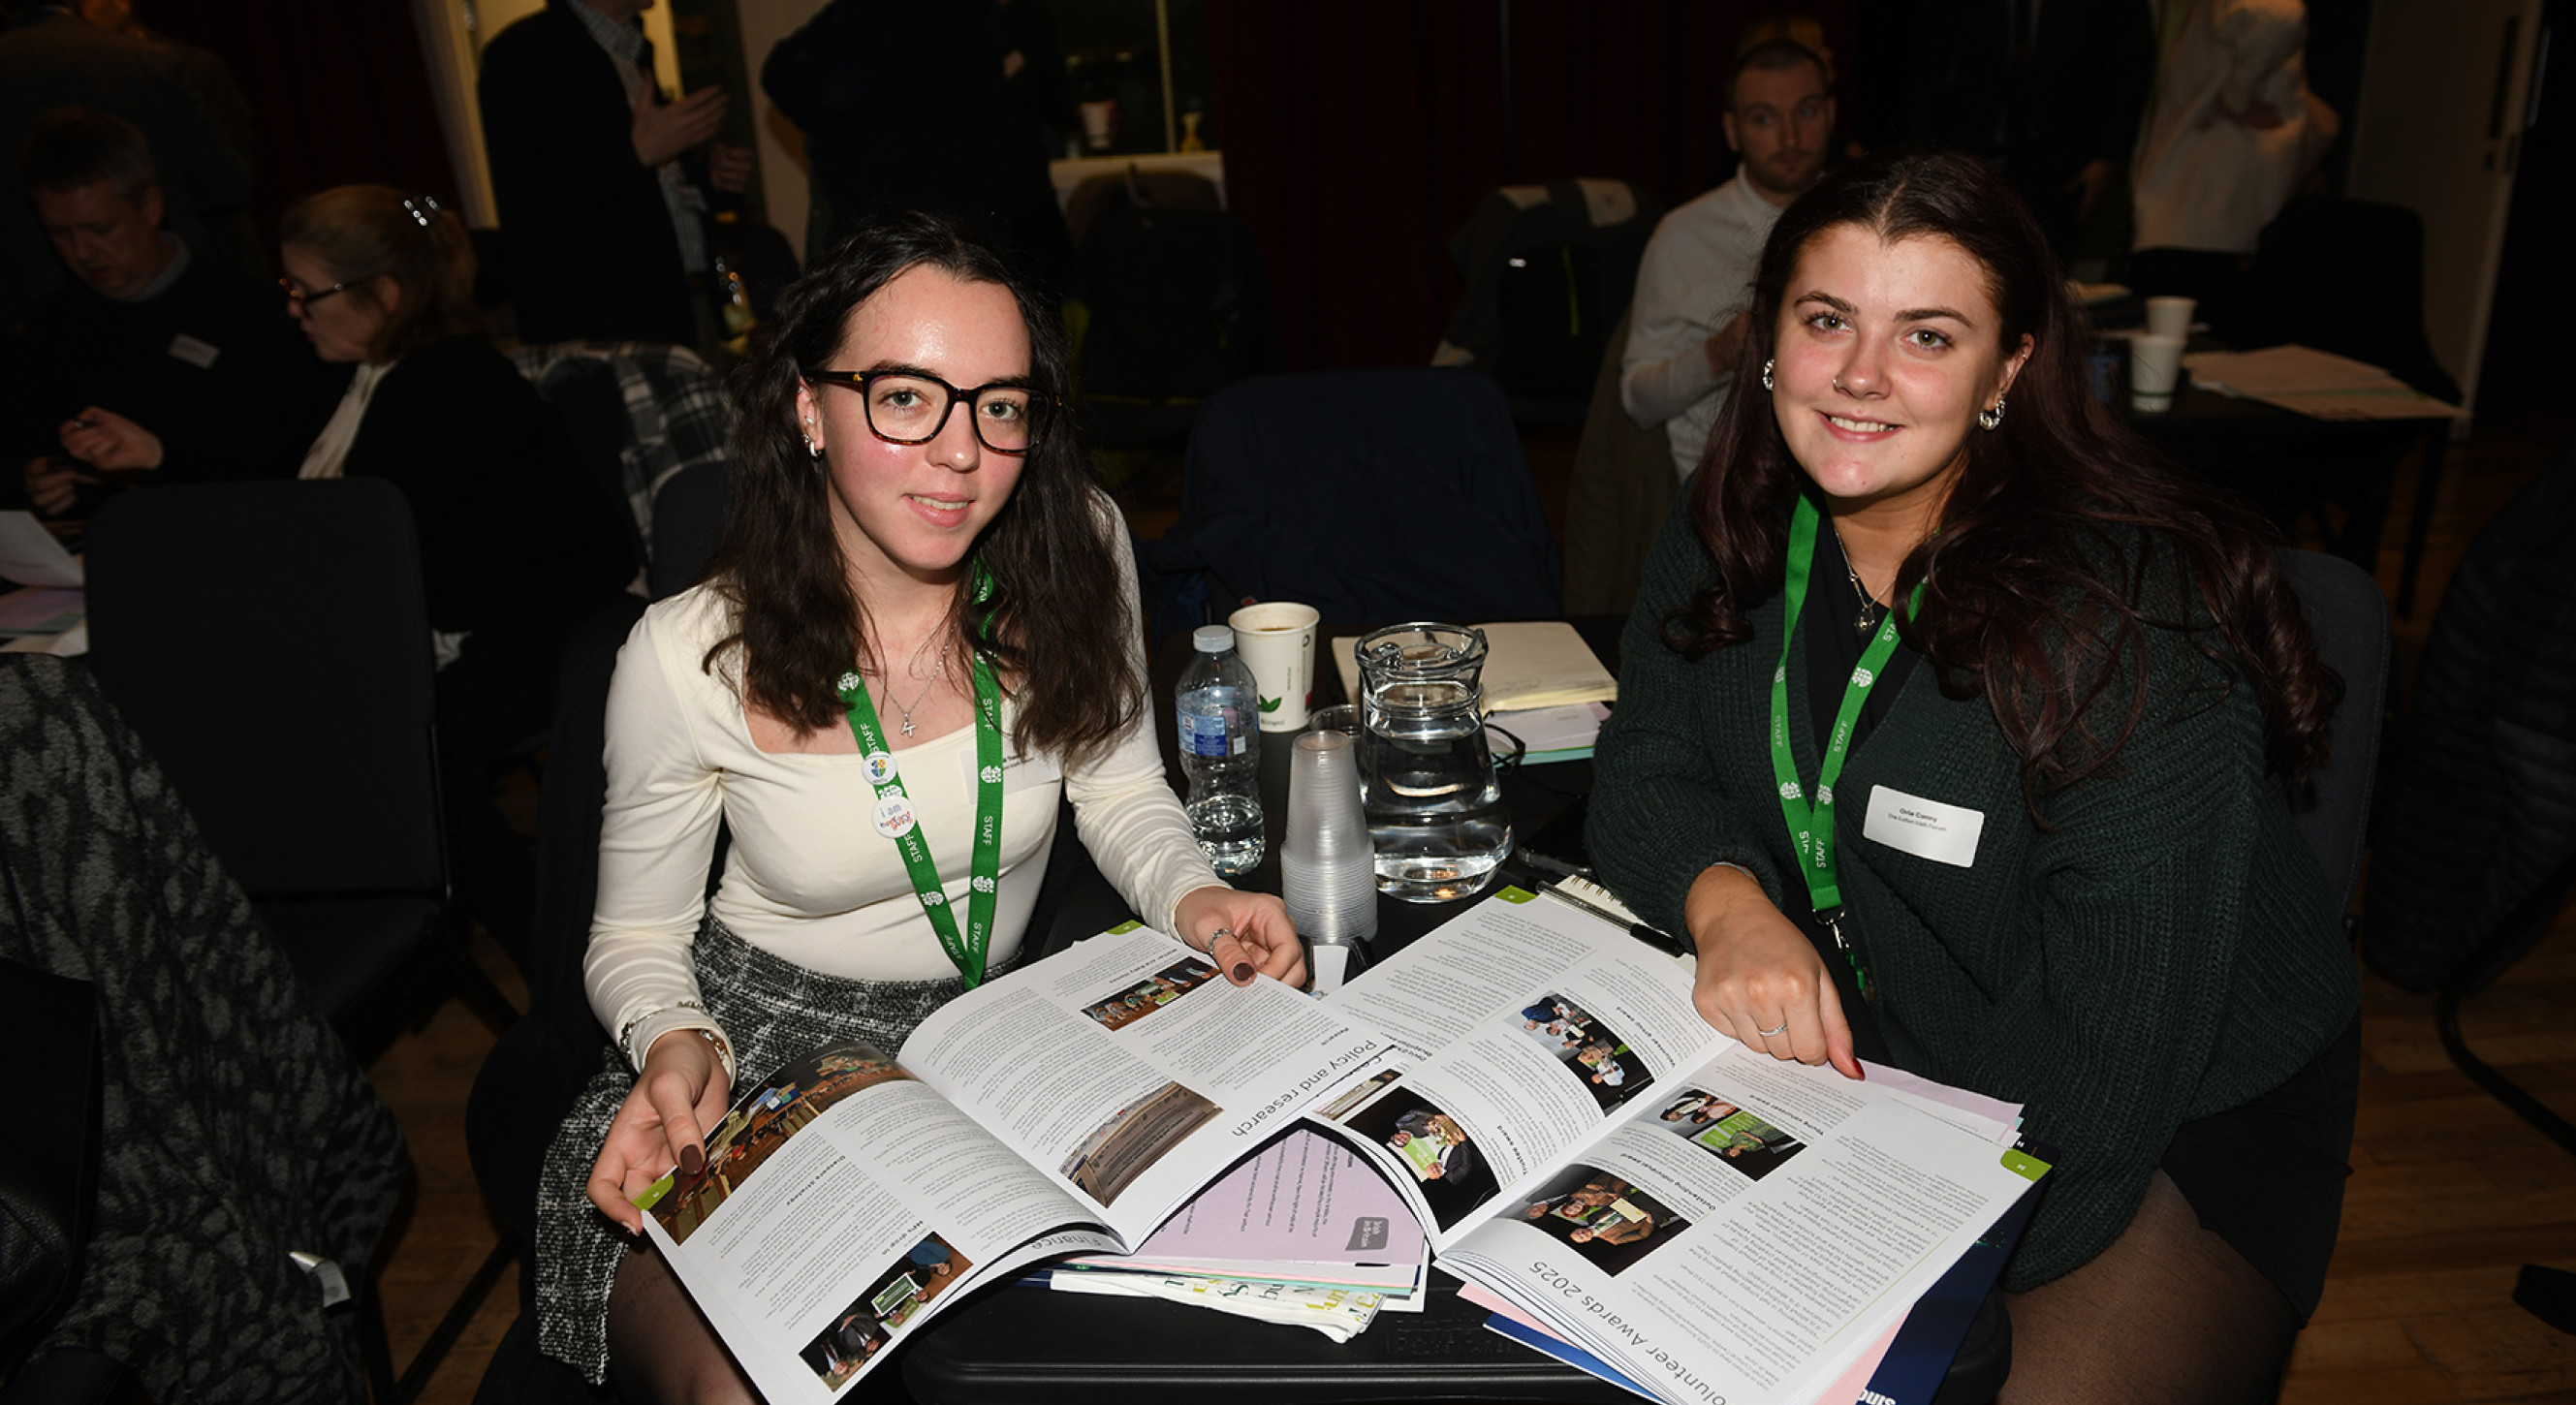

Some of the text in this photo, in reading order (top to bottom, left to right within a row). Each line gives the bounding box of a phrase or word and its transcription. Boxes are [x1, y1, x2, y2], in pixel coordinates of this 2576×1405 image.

[983, 698, 994, 731] STAFF
[1775, 715, 1783, 747] STAFF
[1834, 720, 1848, 753] STAFF
[983, 815, 993, 846] STAFF
[903, 832, 923, 863] STAFF
[1816, 837, 1826, 868] STAFF
[972, 921, 983, 953] STAFF
[1230, 1032, 1377, 1140] Policy and research
[1030, 1227, 1102, 1260] Finance
[1527, 1256, 1582, 1302] 2025
[1578, 1293, 1649, 1352] Awards
